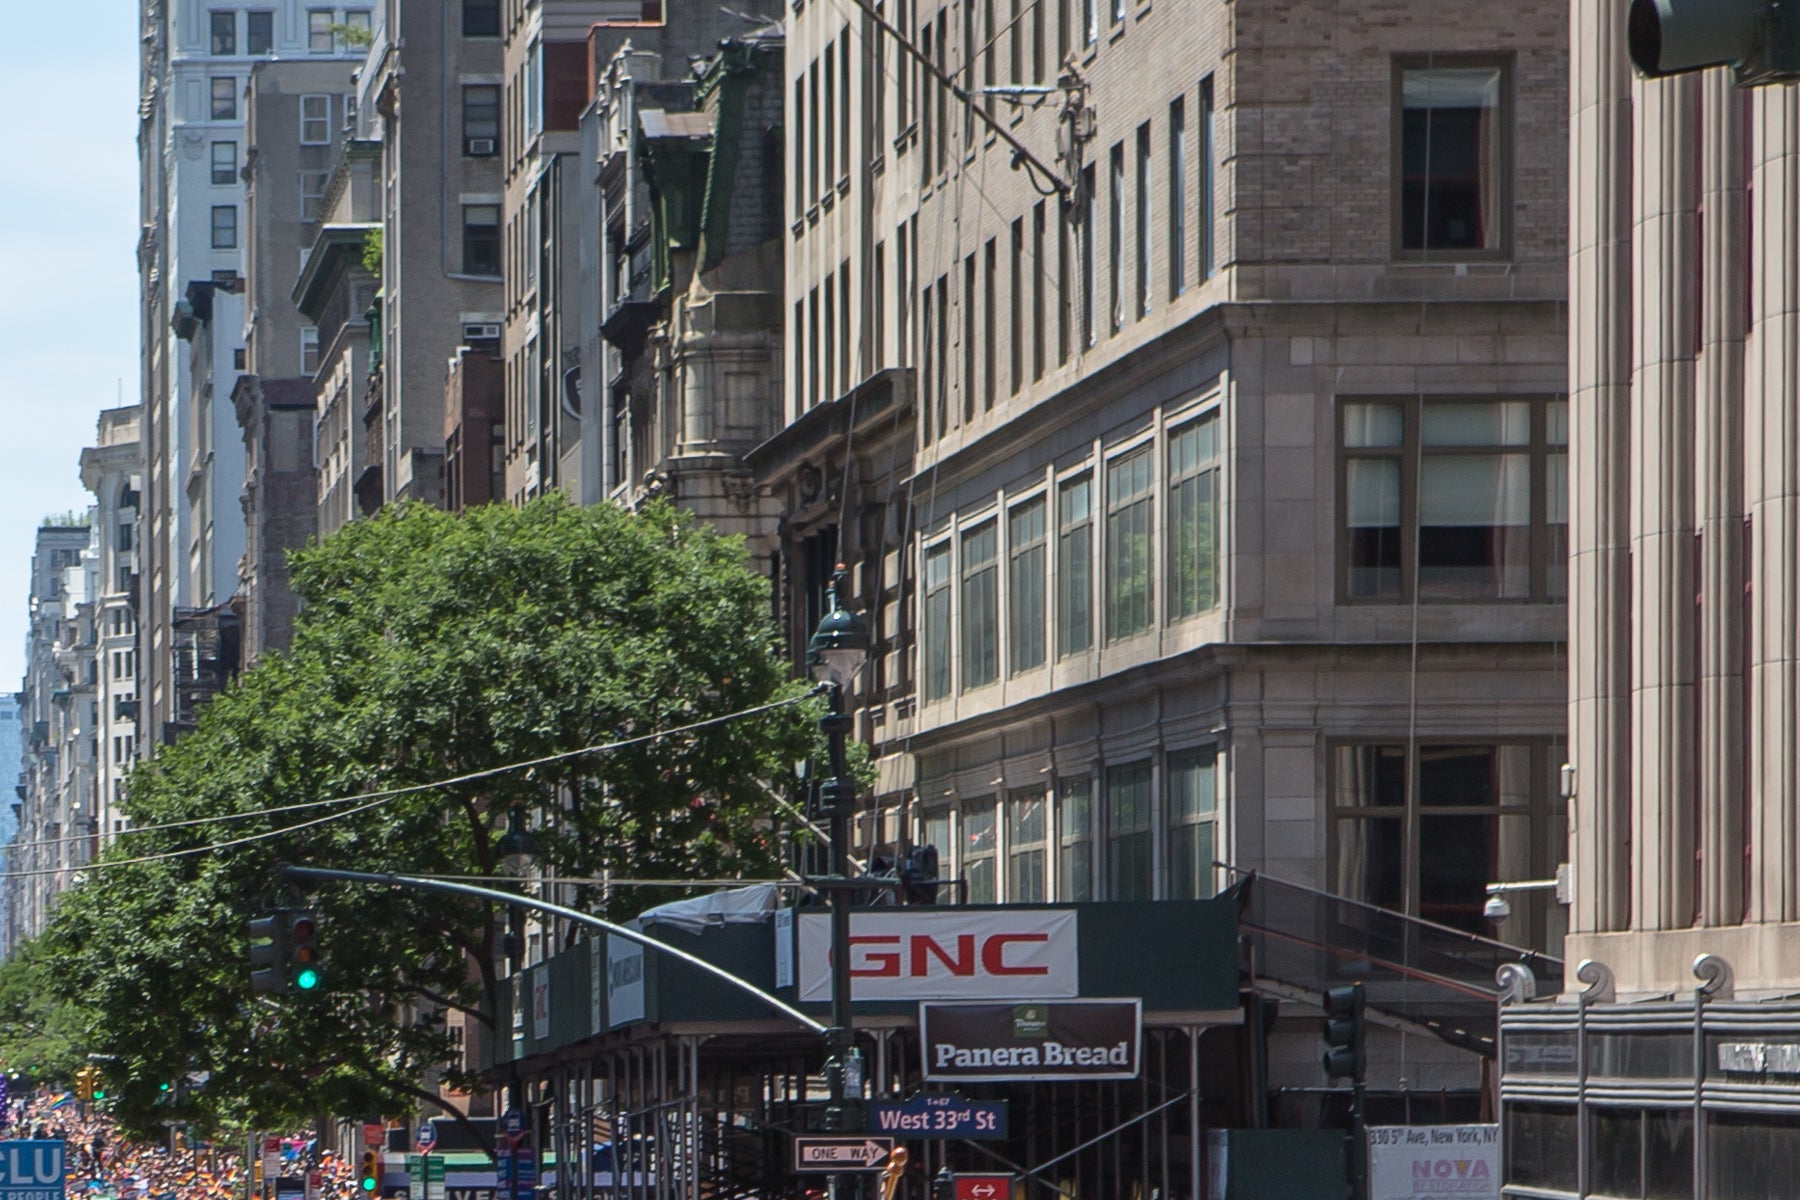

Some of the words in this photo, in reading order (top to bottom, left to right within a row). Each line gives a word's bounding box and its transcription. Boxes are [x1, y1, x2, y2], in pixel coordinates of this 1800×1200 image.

[828, 933, 1048, 978] GNC
[935, 1043, 1040, 1067] Panera
[1042, 1041, 1129, 1067] Bread
[879, 1110, 930, 1130] West
[934, 1108, 971, 1130] 33rd
[975, 1110, 996, 1130] St
[1431, 1129, 1453, 1144] New
[1456, 1128, 1481, 1146] York,
[812, 1148, 838, 1160] ONE
[850, 1147, 879, 1159] WAY
[1412, 1159, 1490, 1178] NOVA
